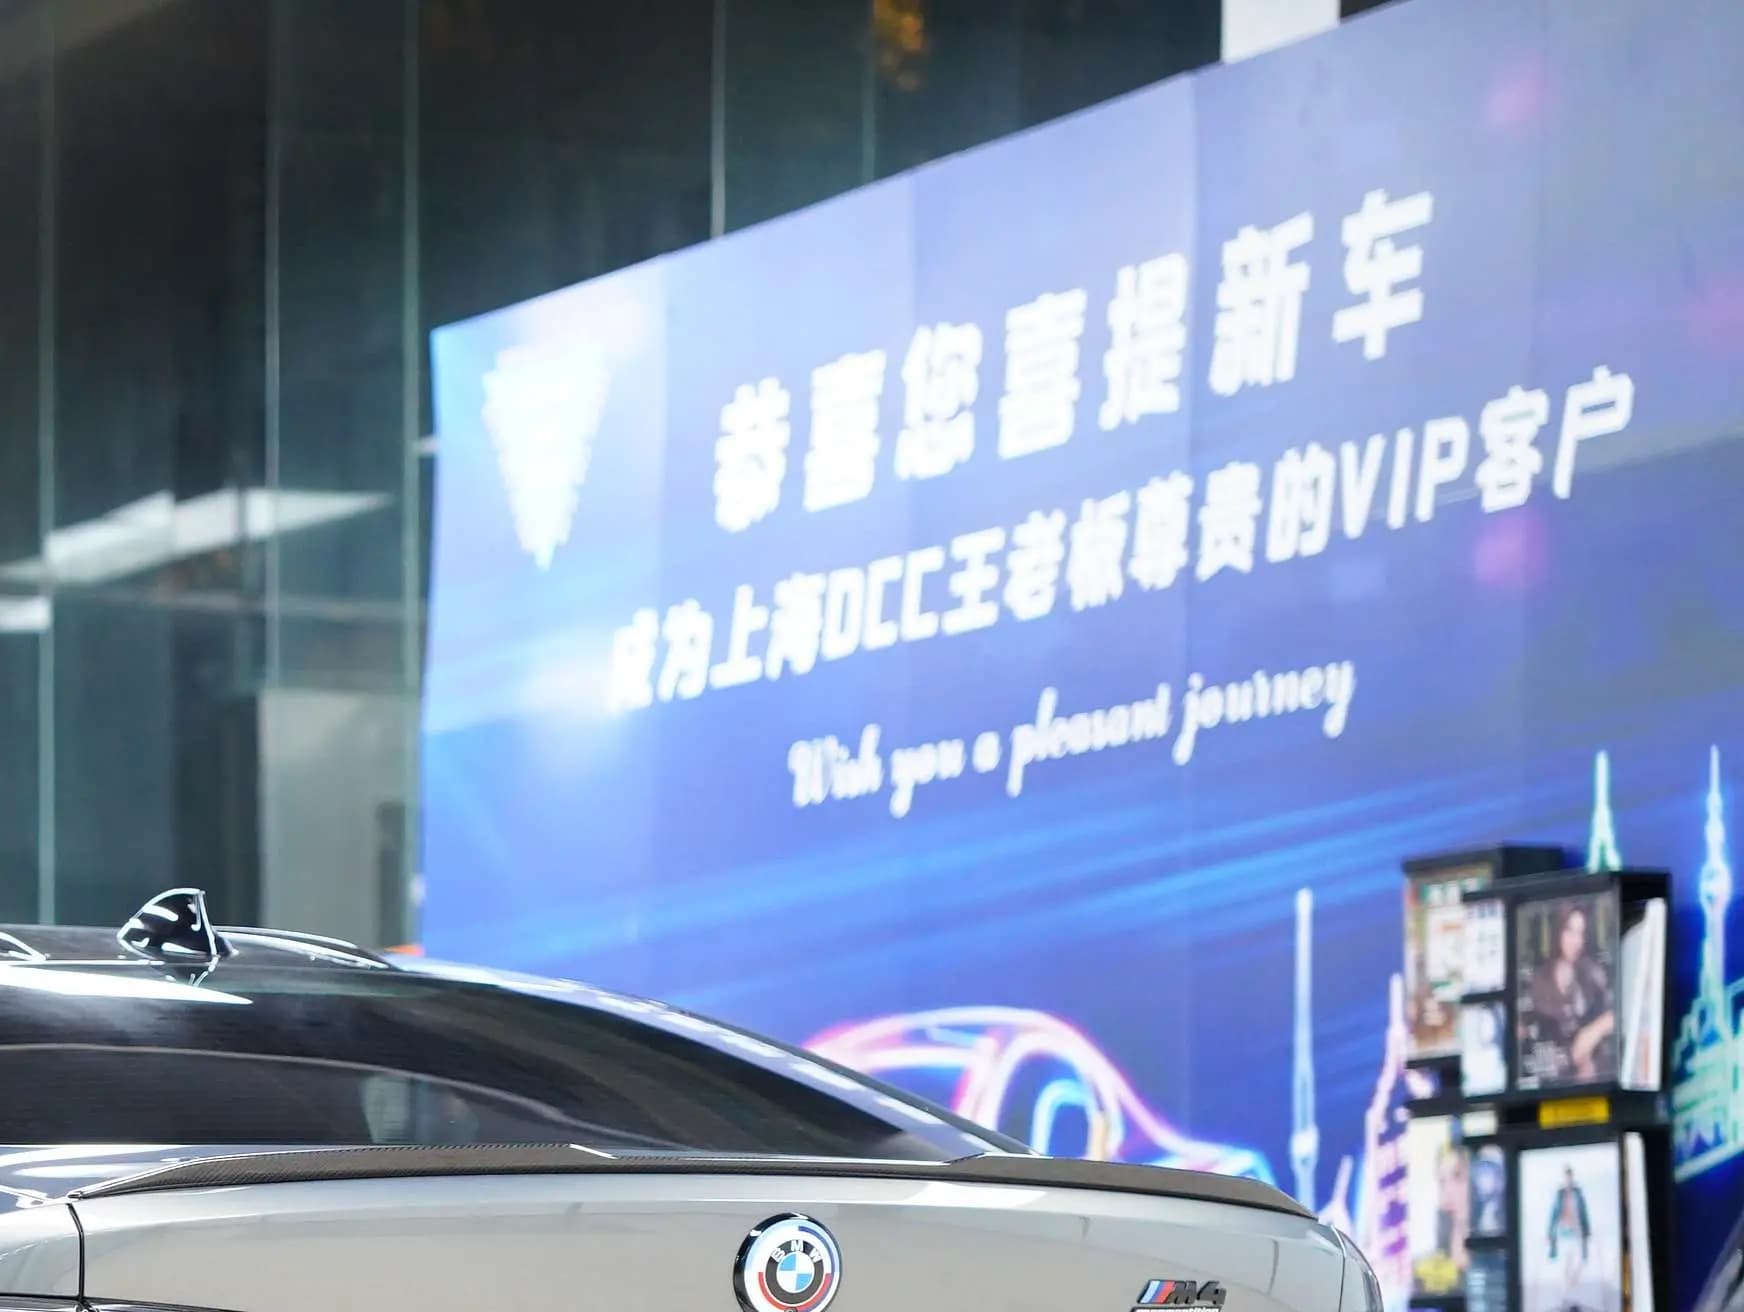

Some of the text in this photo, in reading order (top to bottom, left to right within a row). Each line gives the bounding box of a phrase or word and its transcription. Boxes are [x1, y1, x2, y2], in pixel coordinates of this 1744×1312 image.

[713, 187, 1434, 532] 恭喜您喜提新车
[787, 660, 1356, 819] Wish you a pleasant journey
[770, 1239, 823, 1264] BMW
[1138, 1279, 1227, 1306] M4
